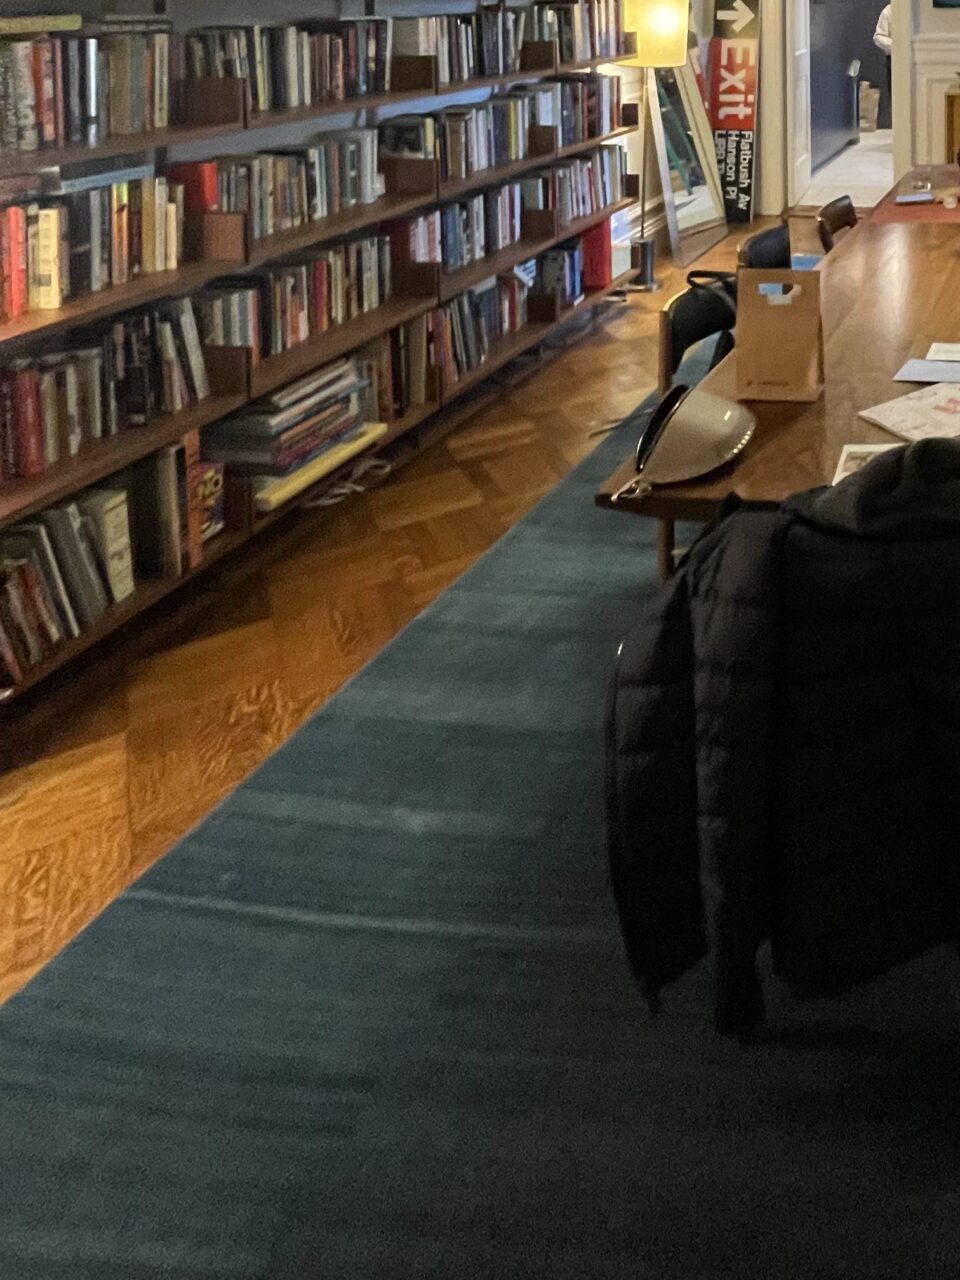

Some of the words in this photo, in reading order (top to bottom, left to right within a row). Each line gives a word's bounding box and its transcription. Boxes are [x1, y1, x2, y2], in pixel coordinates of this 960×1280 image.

[718, 38, 756, 120] Exit
[725, 131, 739, 181] Hanson
[738, 131, 752, 188] Flatbush
